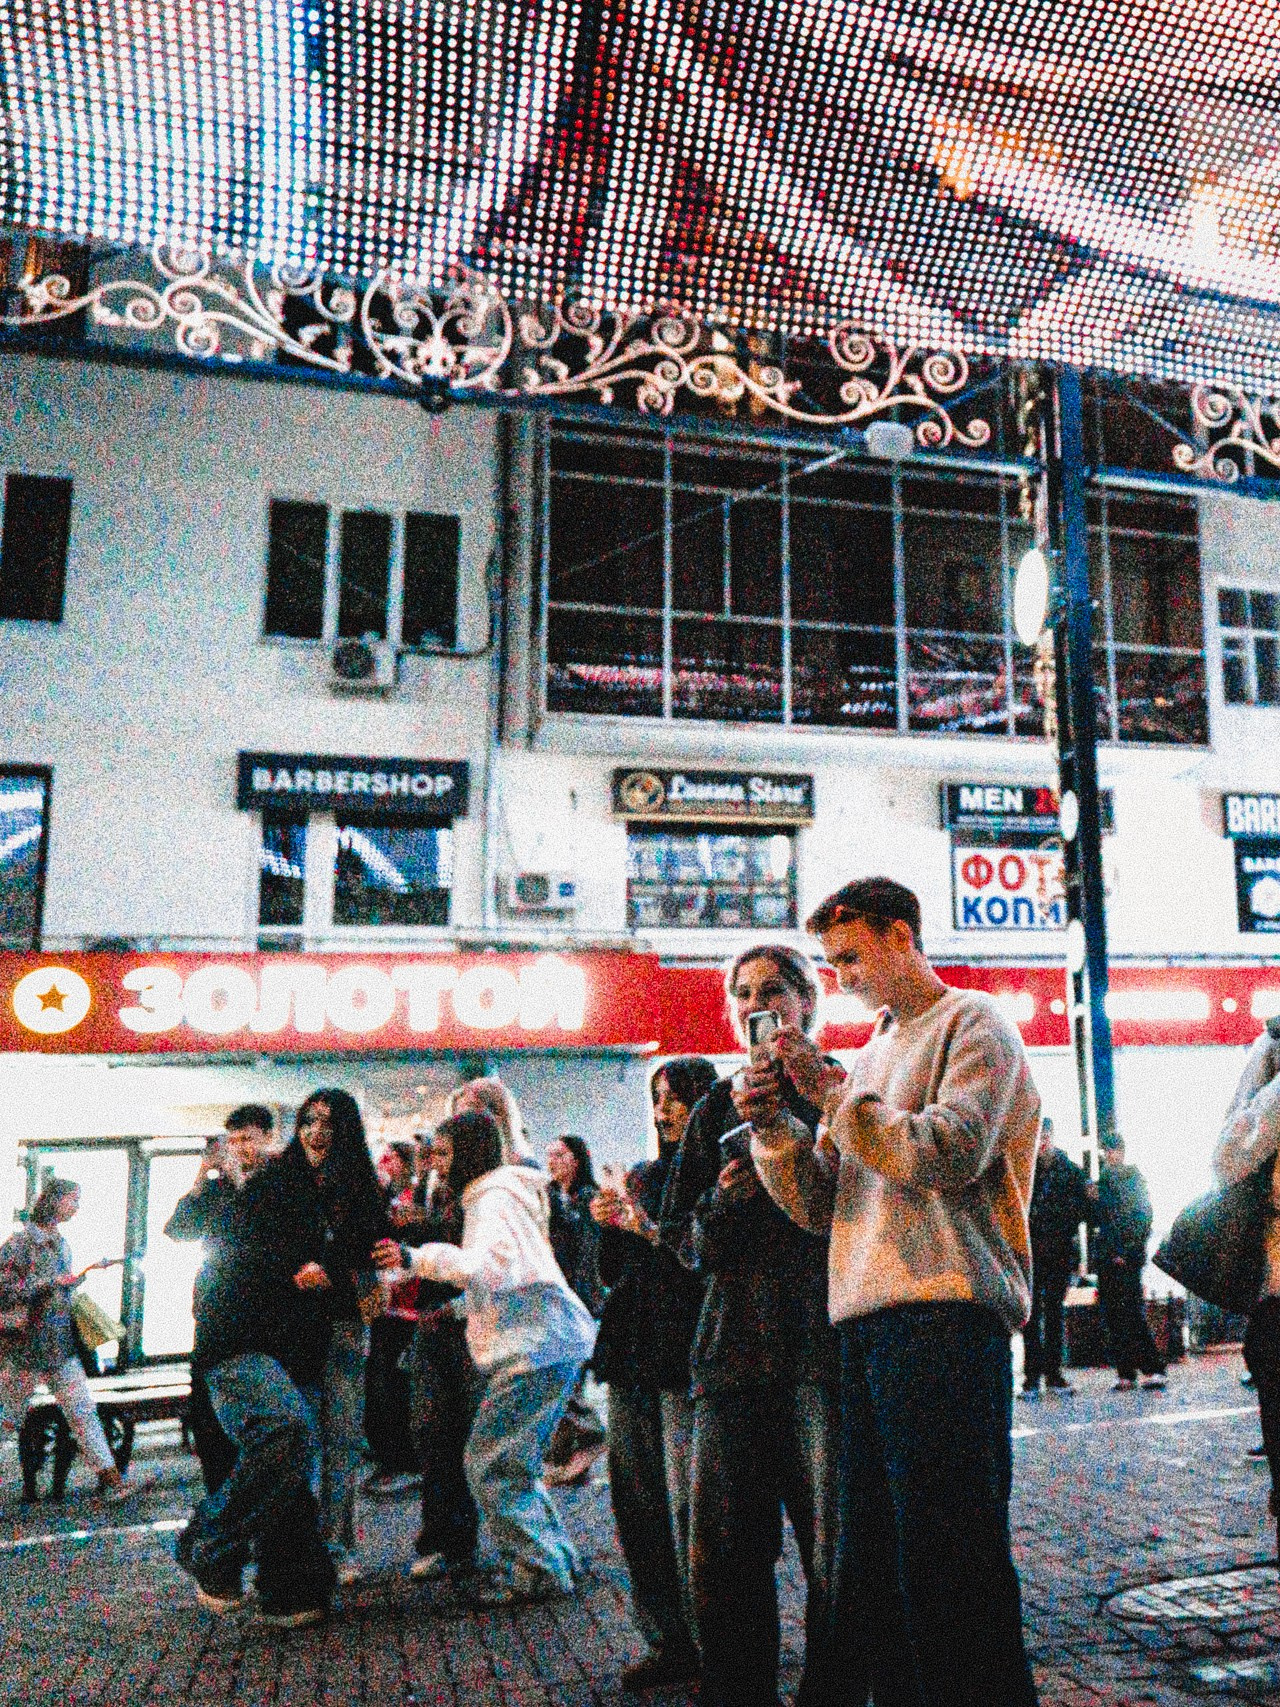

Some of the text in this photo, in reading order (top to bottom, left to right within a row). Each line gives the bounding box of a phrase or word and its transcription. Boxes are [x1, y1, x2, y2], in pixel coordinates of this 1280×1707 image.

[252, 769, 456, 799] BARBERSHOP
[959, 786, 1024, 812] MEN
[961, 853, 1067, 892] ФОТ
[118, 955, 587, 1033] ЗОЛОТОЙ
